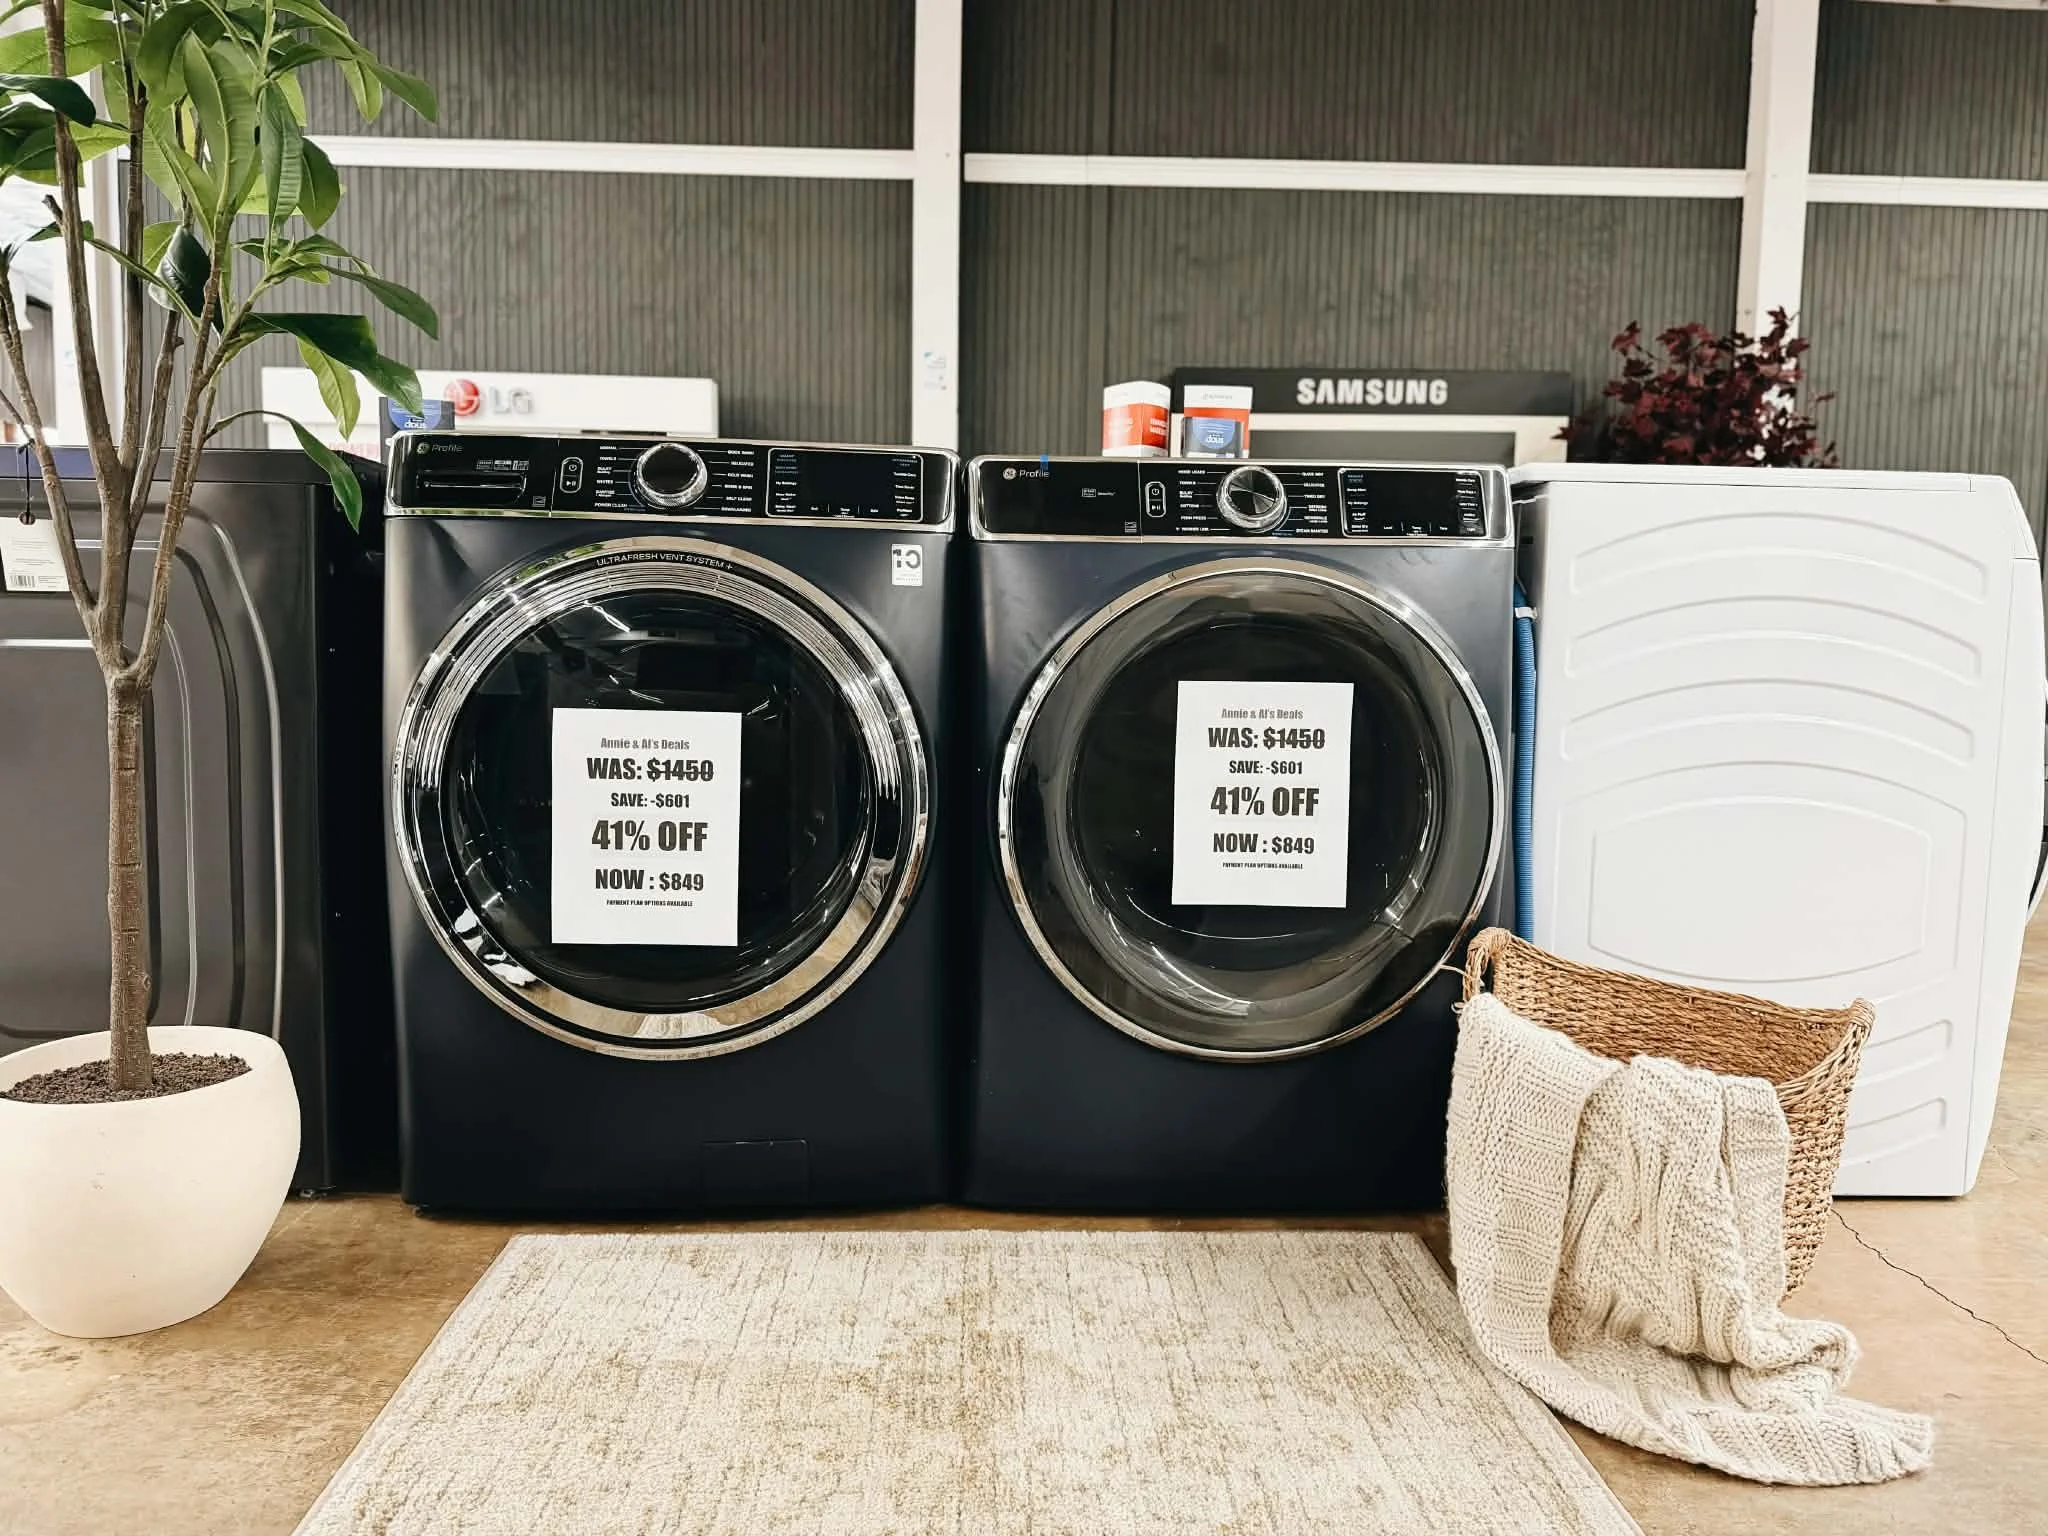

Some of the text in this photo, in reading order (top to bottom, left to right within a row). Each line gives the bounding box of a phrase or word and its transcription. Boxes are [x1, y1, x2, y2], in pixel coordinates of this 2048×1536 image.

[489, 387, 533, 415] LG
[1296, 377, 1449, 405] SAMSUNG
[431, 443, 463, 453] Profile
[1019, 468, 1050, 479] Profile
[596, 552, 658, 567] ULTRAFRESH
[659, 553, 687, 561] VENT
[686, 554, 725, 568] SYSTEM
[1221, 708, 1249, 719] Annie
[1276, 708, 1304, 720] Deals
[600, 737, 690, 751] Annie & Al's Deals
[1207, 726, 1326, 750] WAS: $1450
[586, 757, 715, 782] WAS: $1450
[1228, 760, 1303, 776] SAVE: -$601
[610, 792, 691, 809] SAVE: -$601
[1210, 786, 1320, 817] 41% OFF
[591, 819, 709, 852] 41% OFF
[1212, 832, 1259, 854] NOW
[1271, 835, 1316, 856] $849
[594, 868, 645, 890] NOW
[658, 871, 705, 892] $849
[644, 899, 666, 907] OPTIONS
